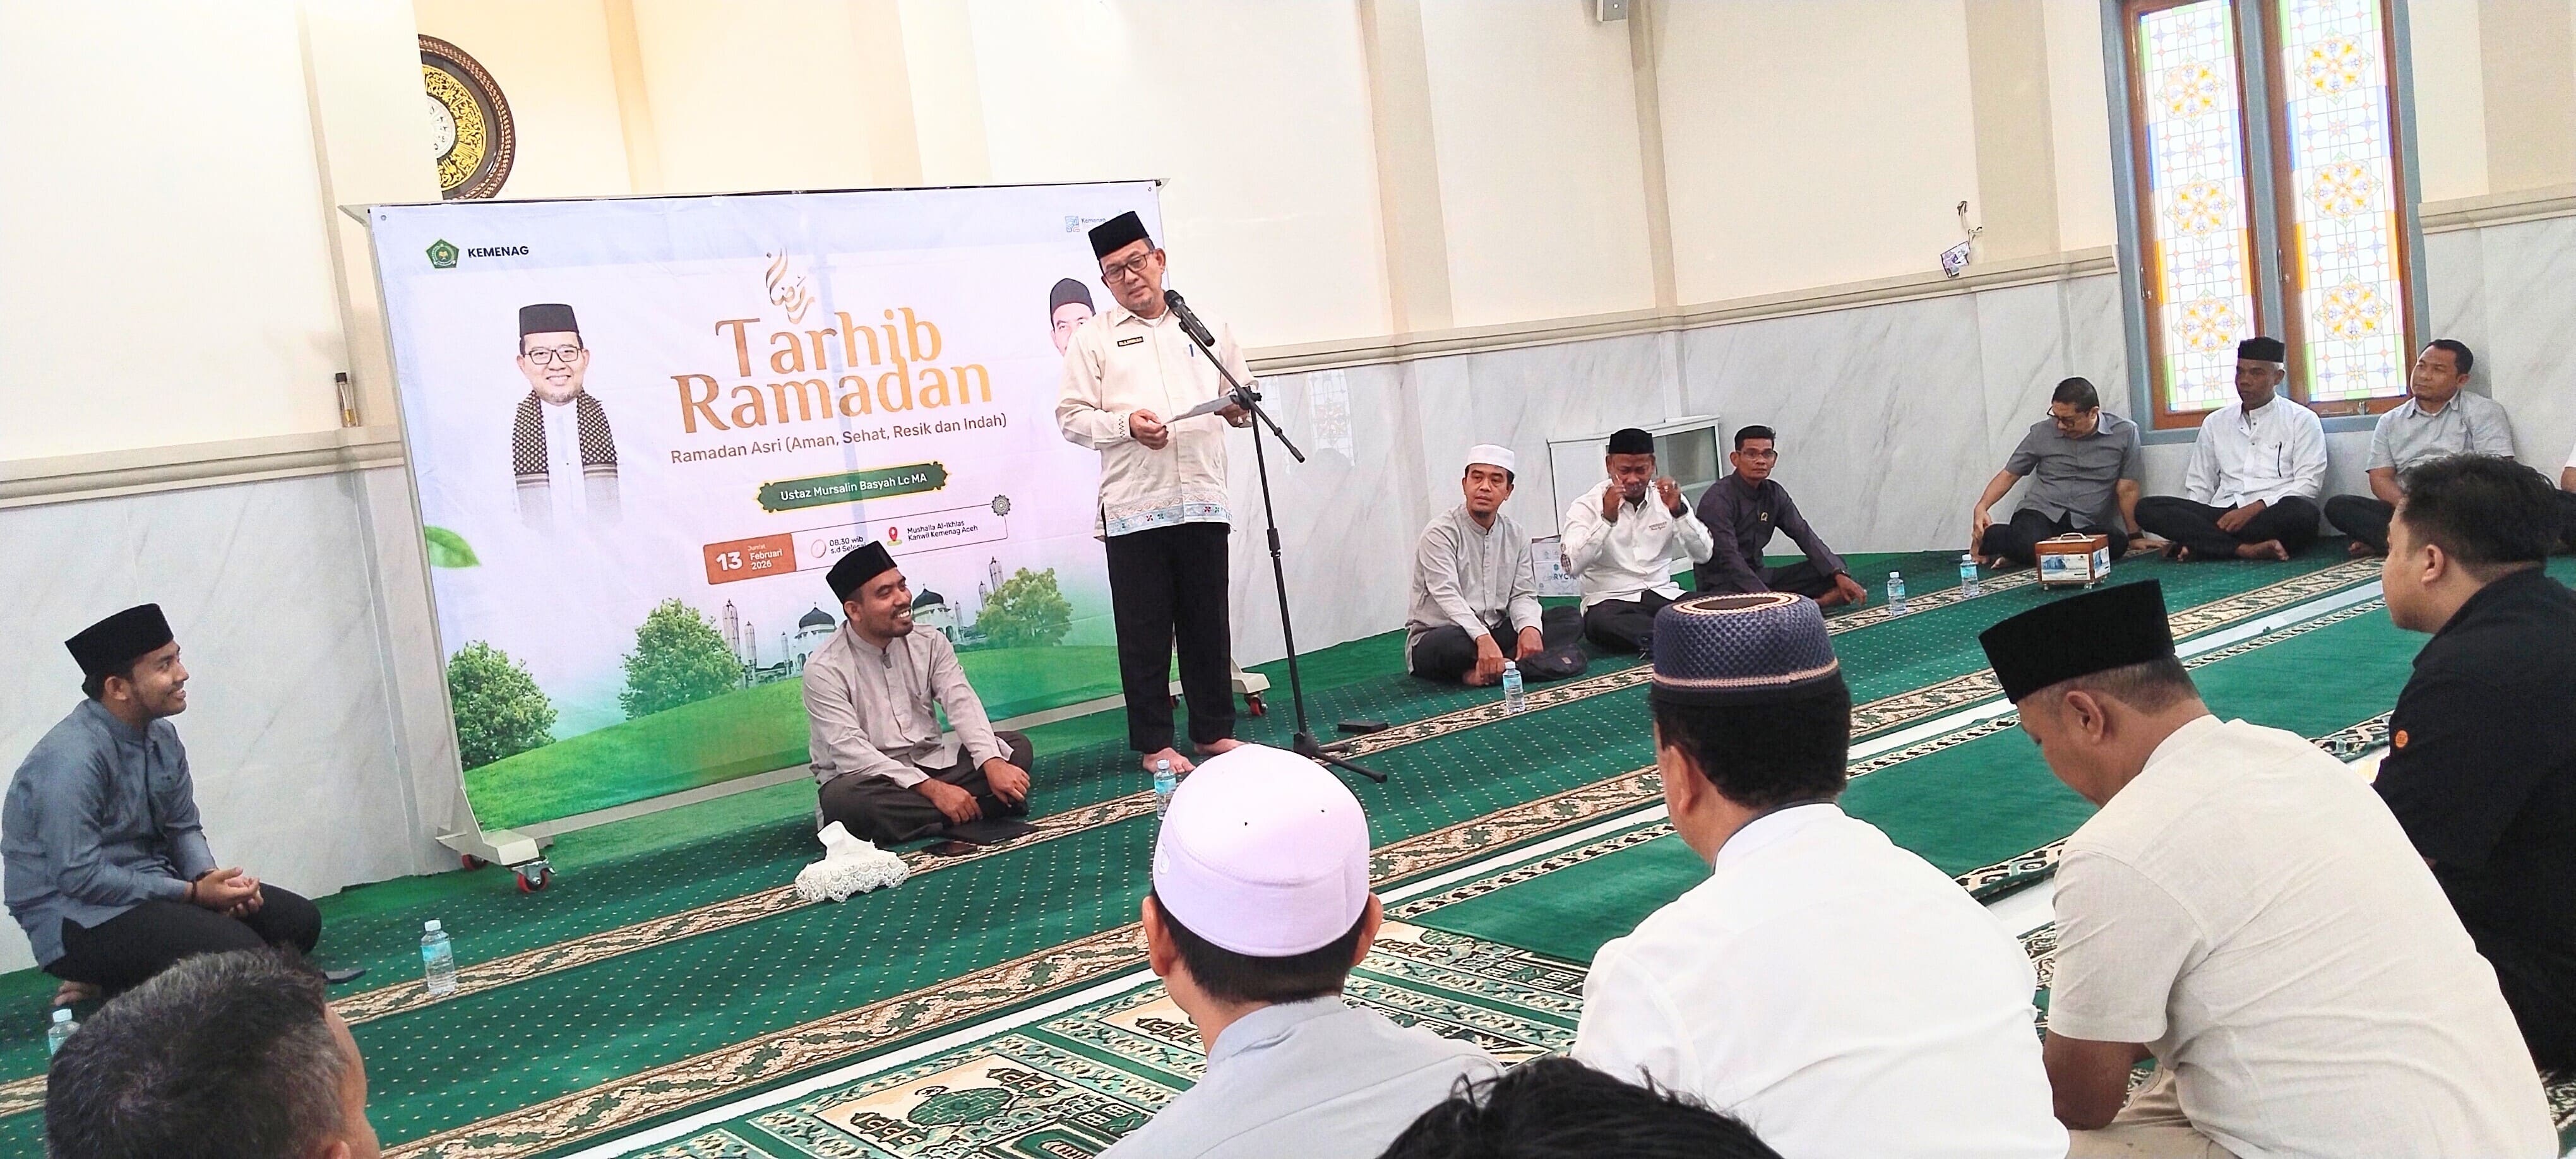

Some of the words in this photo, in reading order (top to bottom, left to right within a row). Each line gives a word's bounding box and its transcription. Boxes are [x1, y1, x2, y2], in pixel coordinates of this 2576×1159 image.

[468, 246, 529, 258] KEMENAG
[715, 307, 941, 377] Tarhib
[671, 355, 992, 433] Ramadan
[671, 445, 747, 463] Ramadan
[751, 438, 782, 454] Asri
[785, 436, 839, 453] (Aman,
[842, 427, 890, 444] Sehat,
[893, 422, 932, 438] Resik
[934, 421, 961, 433] dan
[964, 413, 1006, 430] Indah)
[780, 490, 811, 501] Ustaz
[814, 484, 857, 497] Mursalin
[859, 477, 897, 492] Basyah
[898, 476, 910, 485] Lc
[912, 473, 927, 484] MA
[907, 525, 936, 533] Mushalla
[937, 521, 965, 529] Al-Ikhlas
[908, 533, 930, 541] Kanwil
[931, 528, 960, 538] Kemenag
[830, 538, 850, 546] 08.30
[749, 548, 783, 560] Februari
[716, 551, 742, 571] 13
[751, 560, 772, 570] 2026
